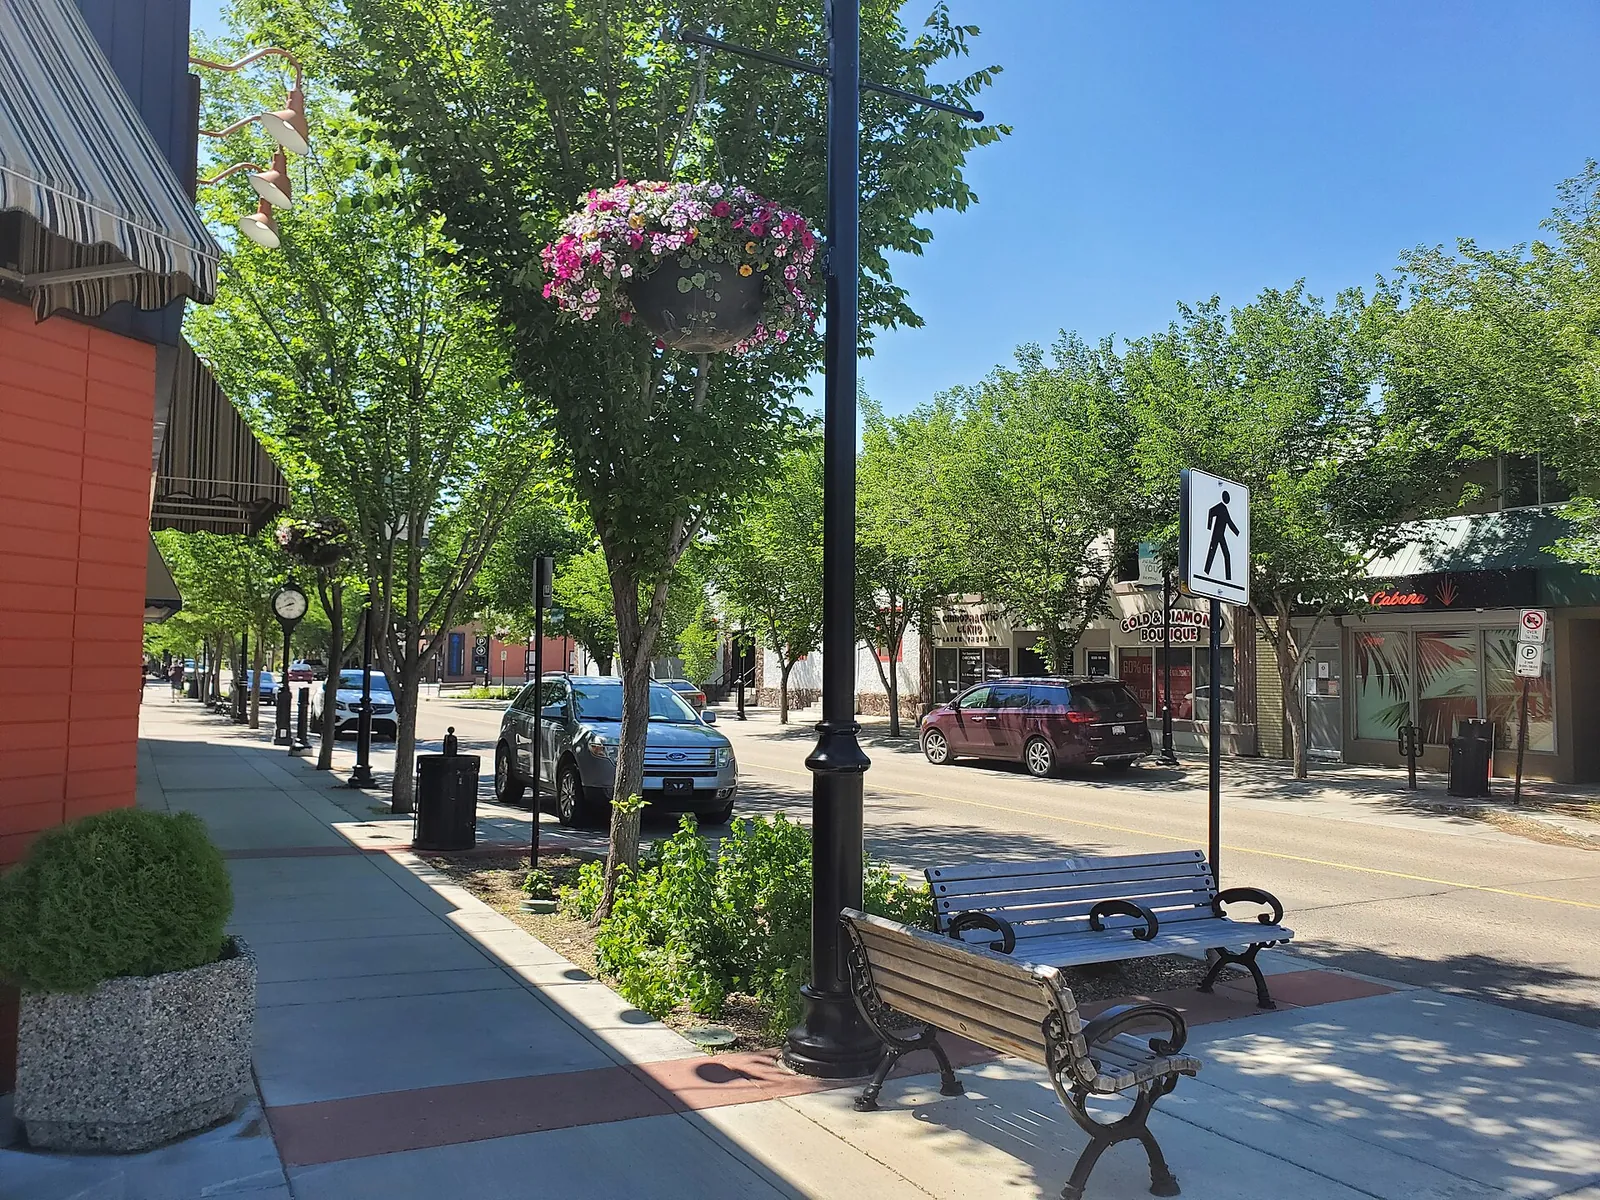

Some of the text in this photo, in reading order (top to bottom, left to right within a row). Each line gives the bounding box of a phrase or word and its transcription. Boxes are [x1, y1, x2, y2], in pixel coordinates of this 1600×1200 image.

[1370, 591, 1428, 606] Cabana
[1121, 613, 1150, 632] GOLD
[1152, 610, 1160, 625] &
[1141, 627, 1197, 642] BOUIQUE
[1123, 660, 1141, 674] 60%
